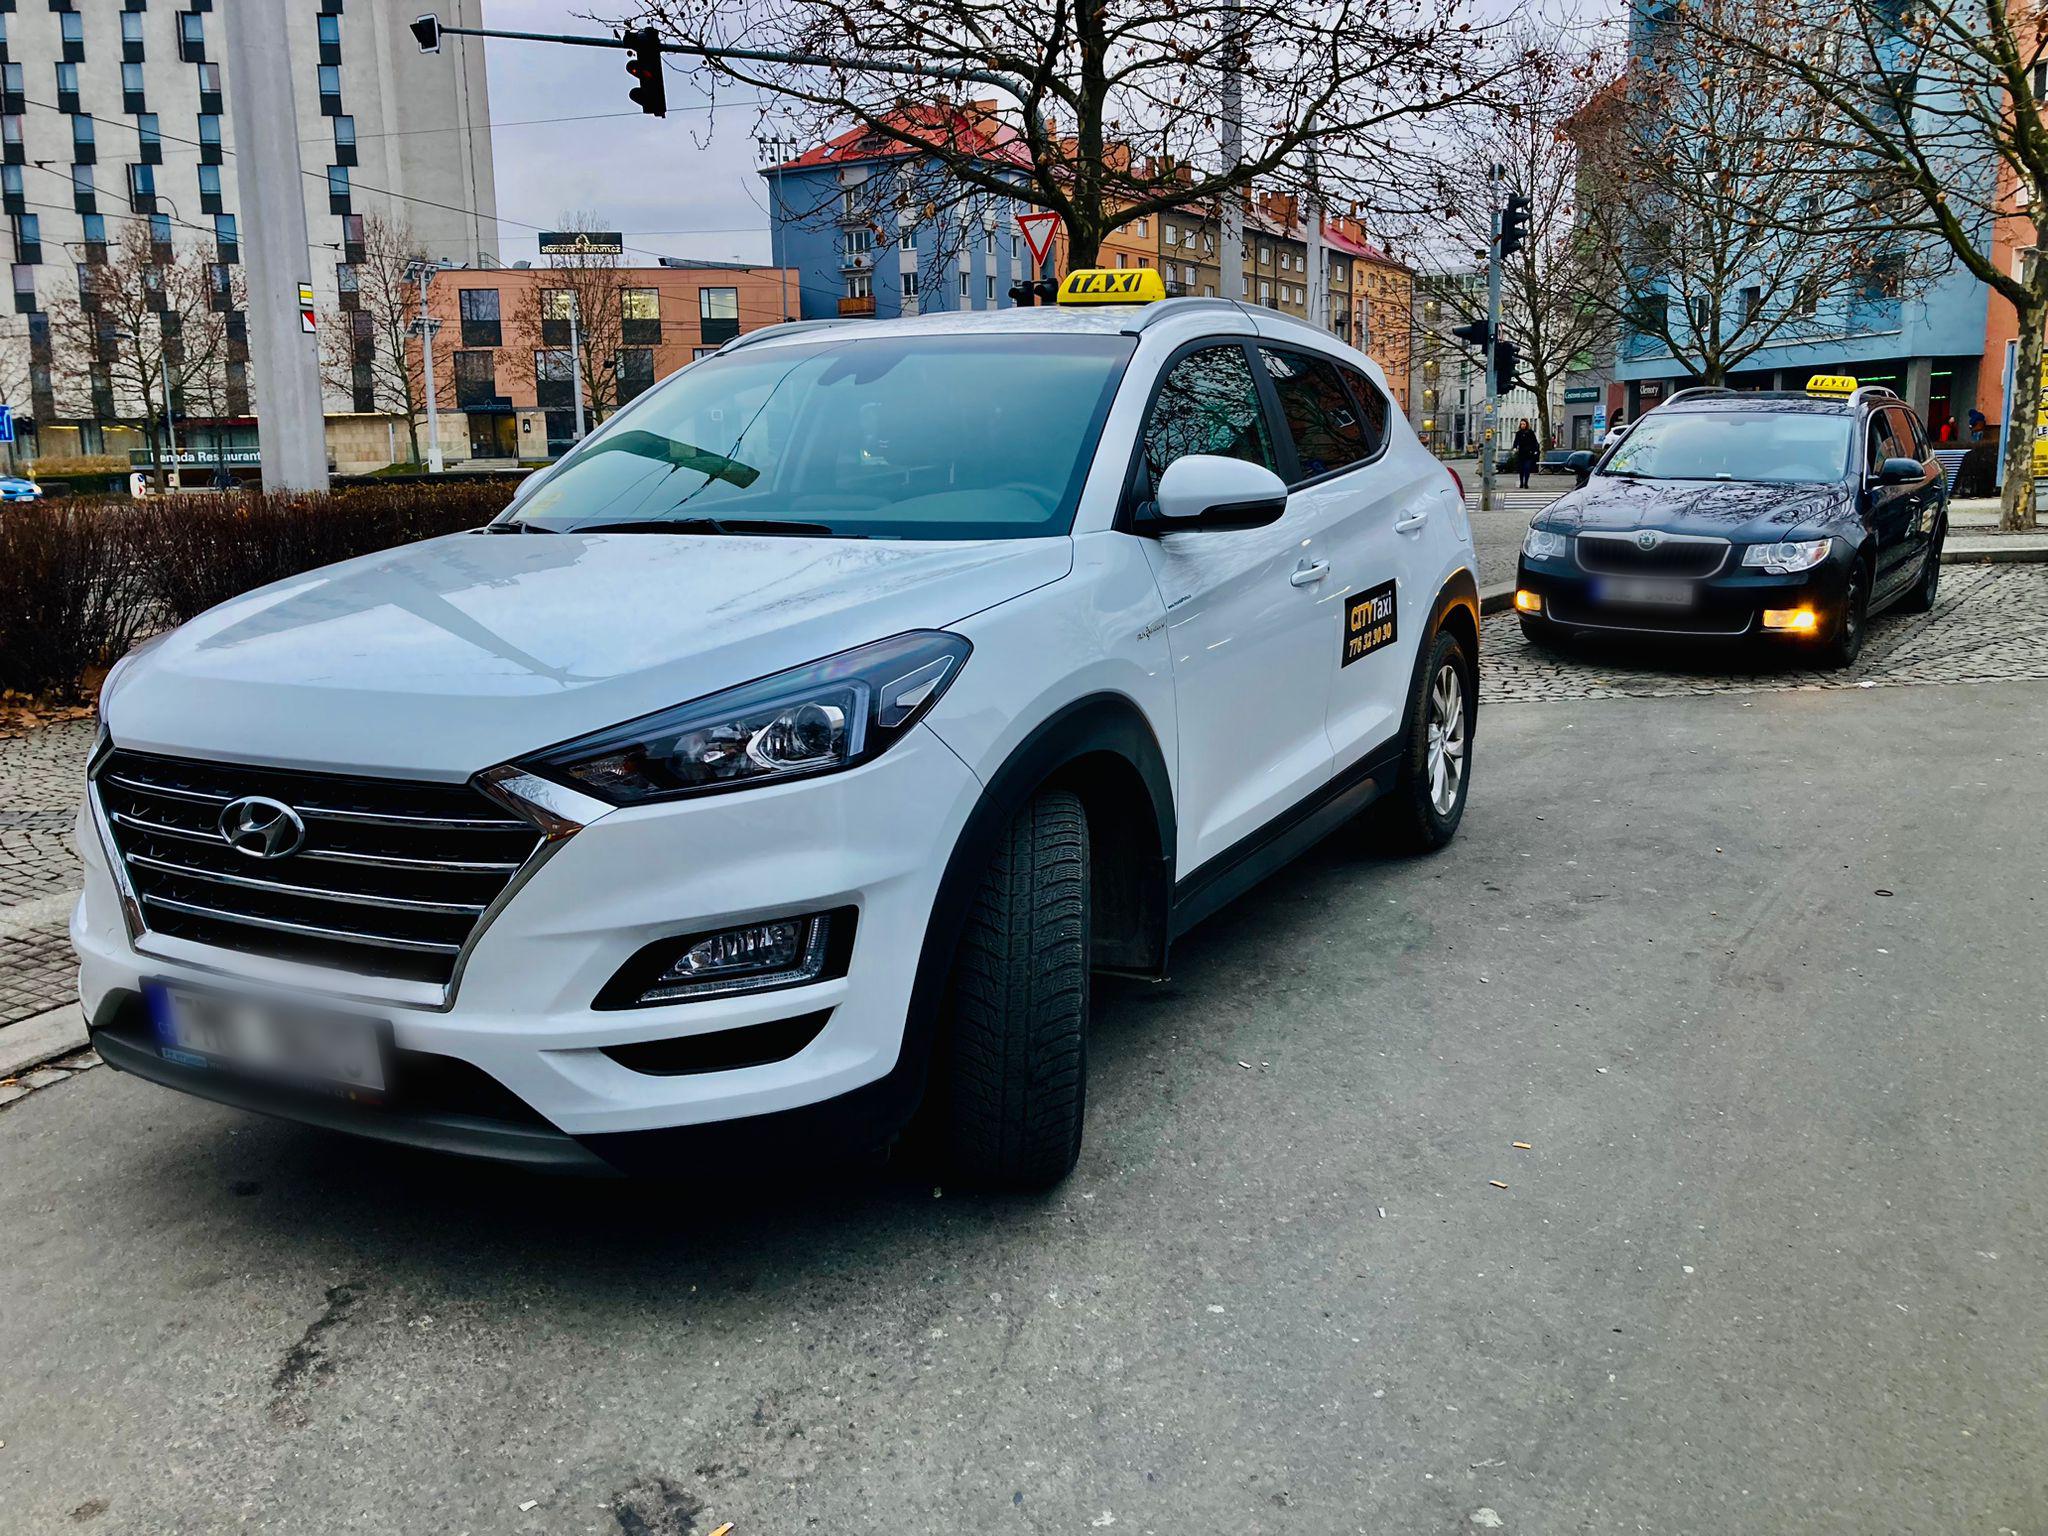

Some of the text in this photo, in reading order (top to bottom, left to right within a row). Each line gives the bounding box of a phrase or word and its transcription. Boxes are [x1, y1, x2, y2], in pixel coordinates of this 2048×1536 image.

[1071, 273, 1140, 293] TAXI
[1813, 378, 1850, 387] TAXI
[524, 423, 531, 432] A
[1349, 635, 1362, 657] 776
